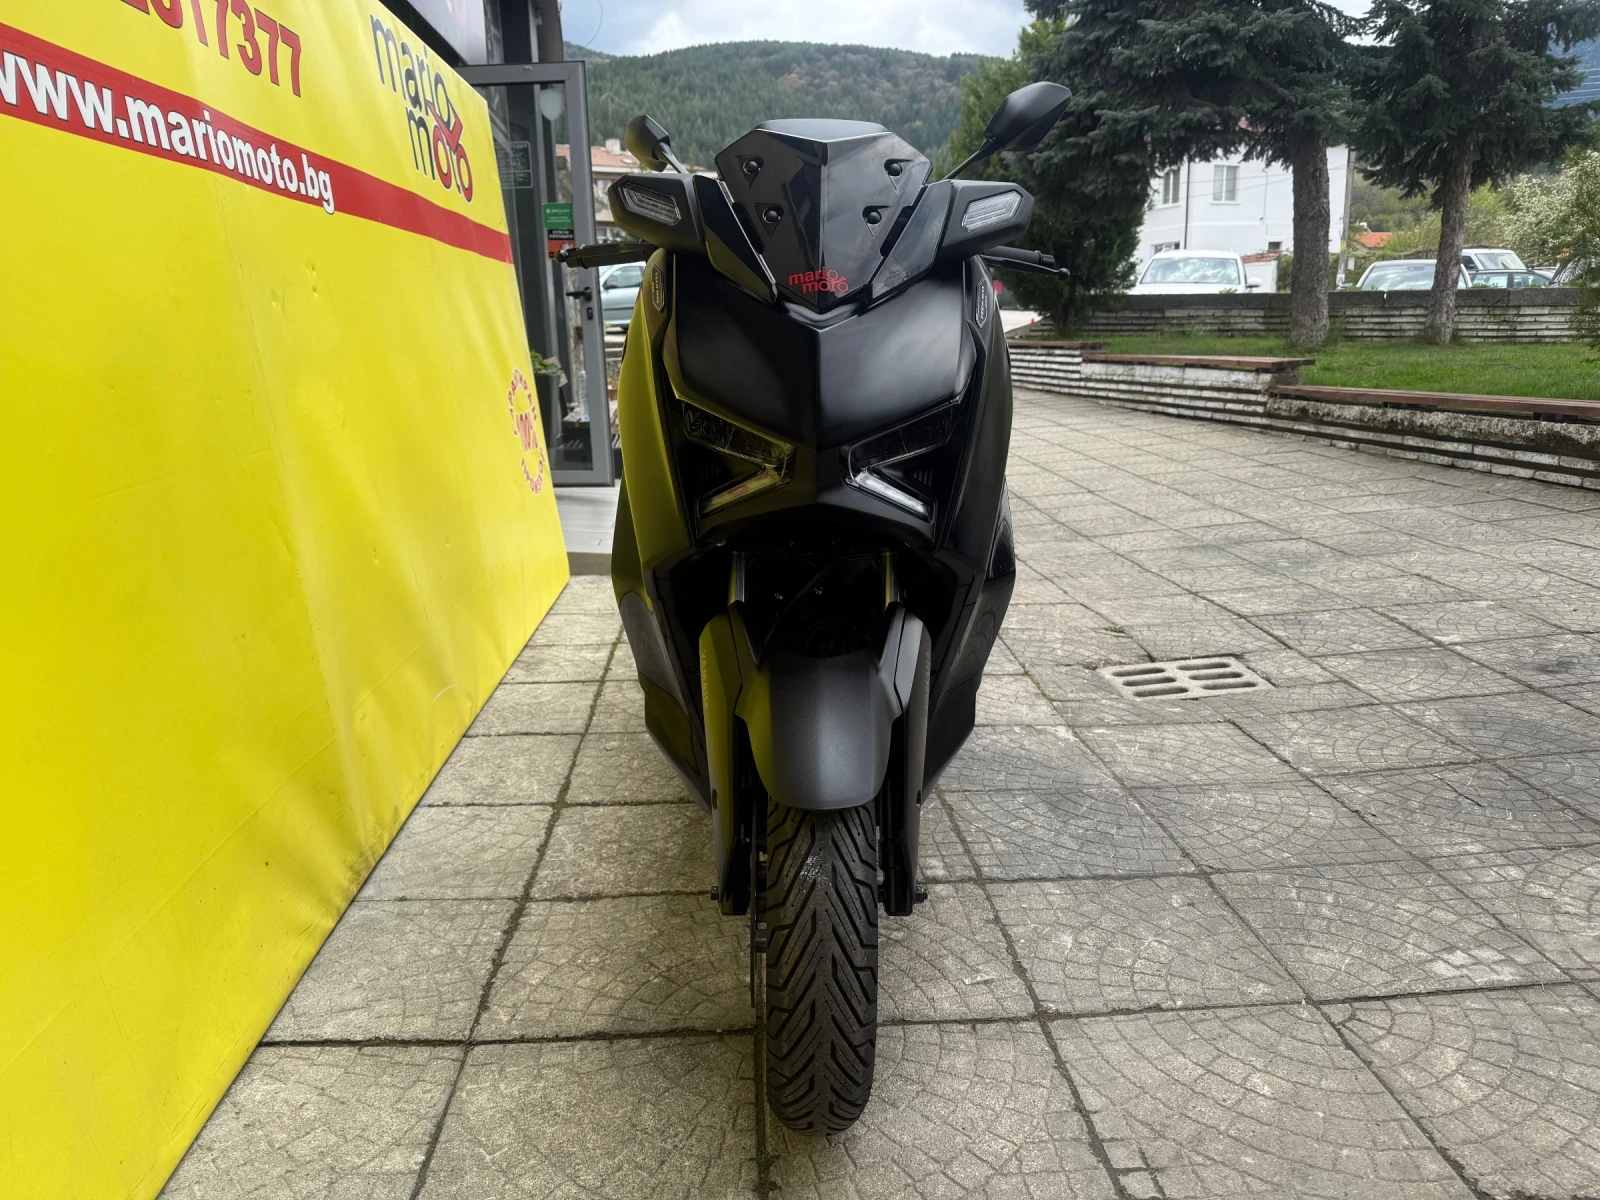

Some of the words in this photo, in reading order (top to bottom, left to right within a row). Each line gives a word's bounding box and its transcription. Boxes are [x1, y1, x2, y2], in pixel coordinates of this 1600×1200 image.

[370, 14, 451, 131] mario
[405, 107, 473, 202] moto
[788, 266, 839, 286] mario
[802, 279, 849, 294] moto
